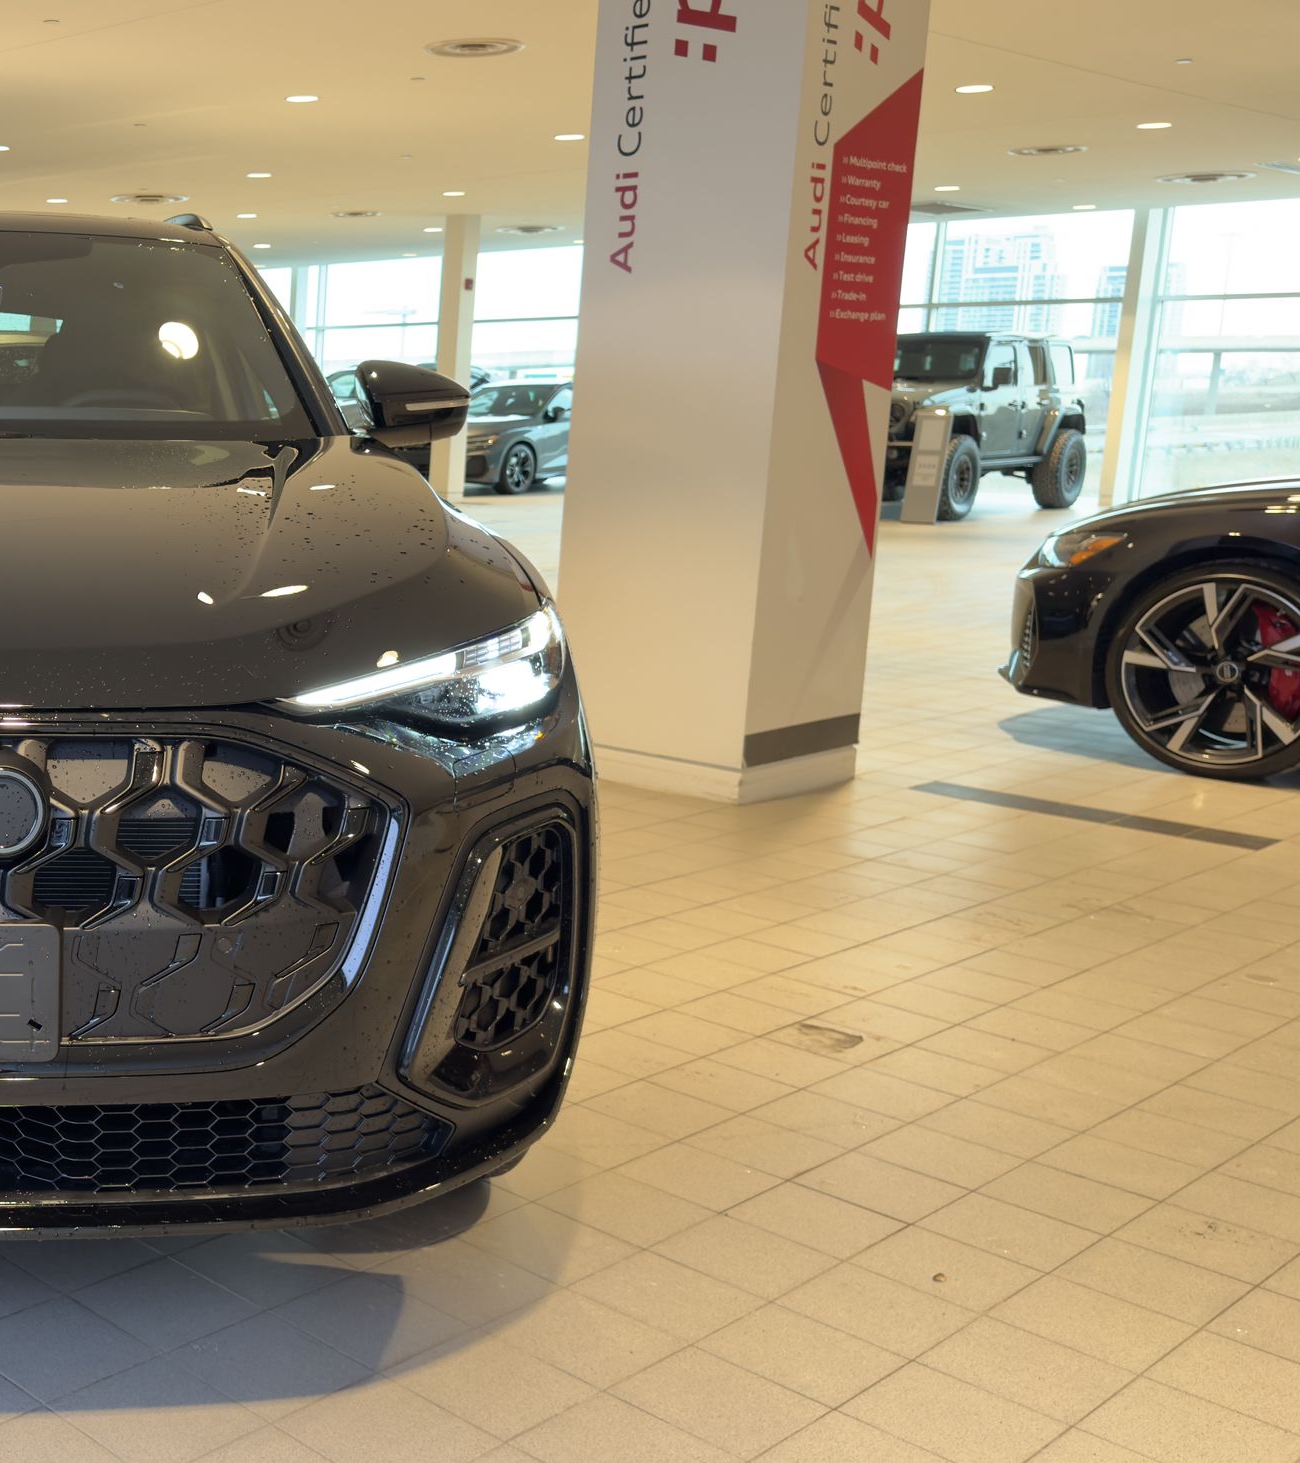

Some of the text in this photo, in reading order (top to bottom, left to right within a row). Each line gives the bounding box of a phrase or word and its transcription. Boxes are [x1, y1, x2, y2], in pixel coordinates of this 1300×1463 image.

[609, 0, 651, 274] Audi Certifie
[803, 4, 841, 271] Audi Certifi
[849, 155, 908, 173] Multipoint check
[847, 174, 881, 191] Warranty
[845, 194, 890, 210] Courtesy car
[843, 213, 878, 229] Financing
[842, 232, 869, 247] Leasing
[840, 252, 875, 265] Insurance
[838, 270, 874, 283] Test drive
[837, 289, 866, 301] Trade-in
[835, 308, 887, 322] Exchange plan
